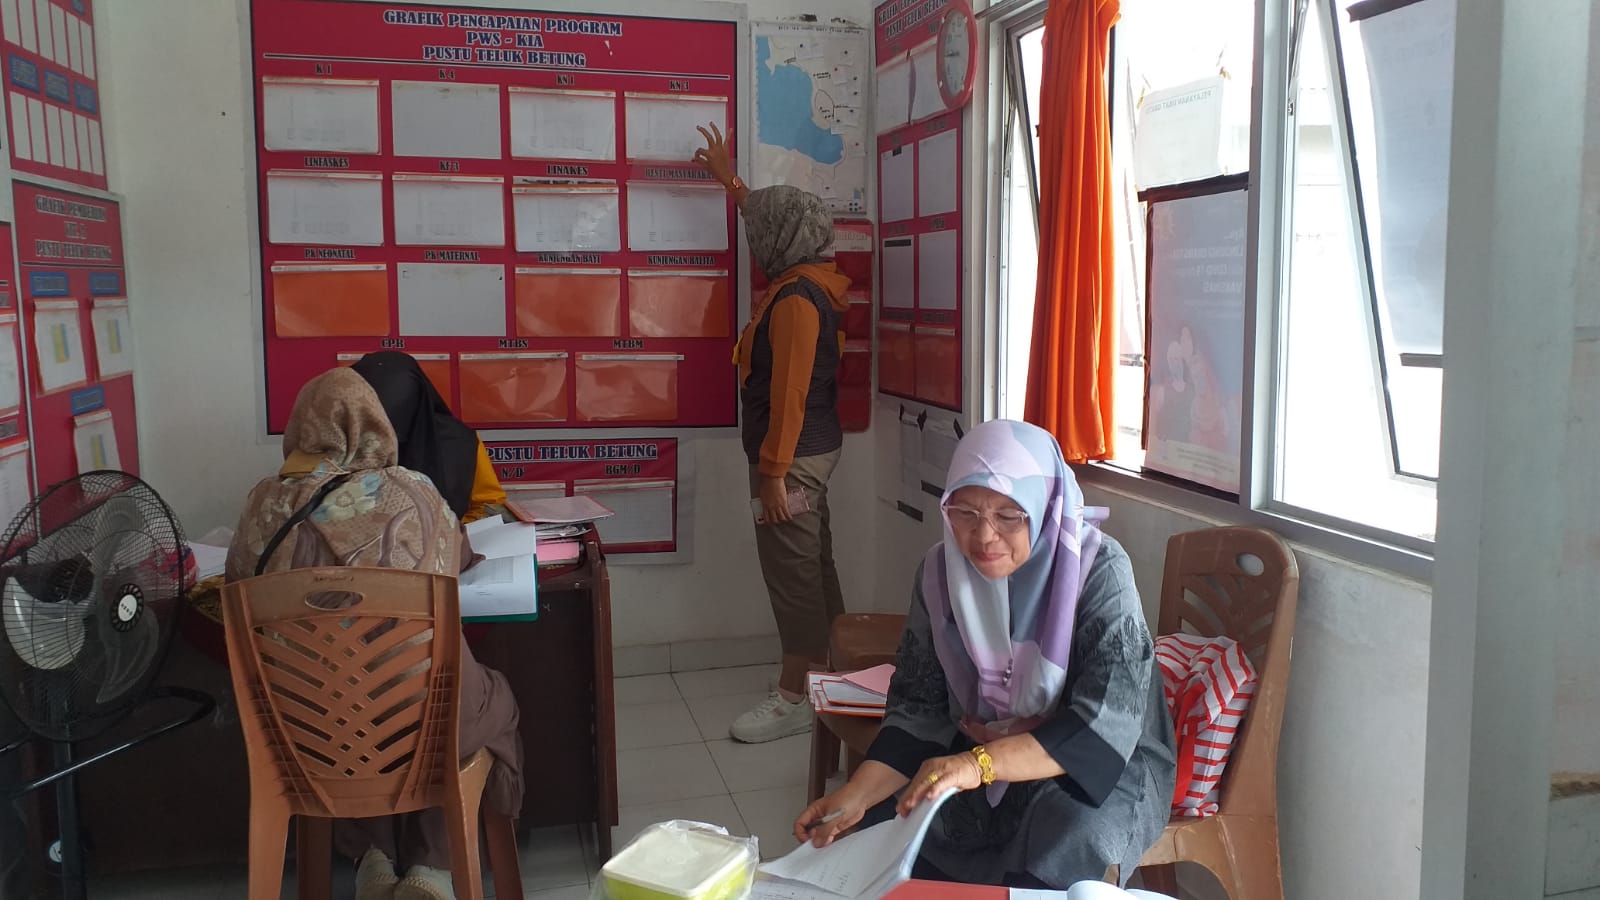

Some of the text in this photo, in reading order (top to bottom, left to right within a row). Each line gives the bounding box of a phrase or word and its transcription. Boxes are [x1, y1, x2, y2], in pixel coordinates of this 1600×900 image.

[384, 10, 622, 36] GRAFIK PENCAPAIAN PROGRAM
[466, 31, 501, 46] PWS
[516, 34, 544, 48] KIA
[423, 46, 586, 67] PUSTU TELUK BETUNG
[315, 64, 323, 74] K
[439, 69, 455, 80] K 4
[557, 74, 568, 86] KN
[669, 80, 680, 91] KN
[304, 157, 349, 168] LINFASKES
[547, 165, 588, 176] LINAKES
[318, 249, 355, 259] NEONATAL
[424, 250, 480, 261] PK MATERNAL
[538, 254, 600, 264] KUNJUNGAN BAYI
[648, 255, 687, 265] KUNJUNGAN
[499, 339, 528, 349] MTBS
[613, 339, 643, 350] MTBM
[487, 444, 658, 461] PUSTU TELUK BETUNG
[502, 467, 525, 478] N/D
